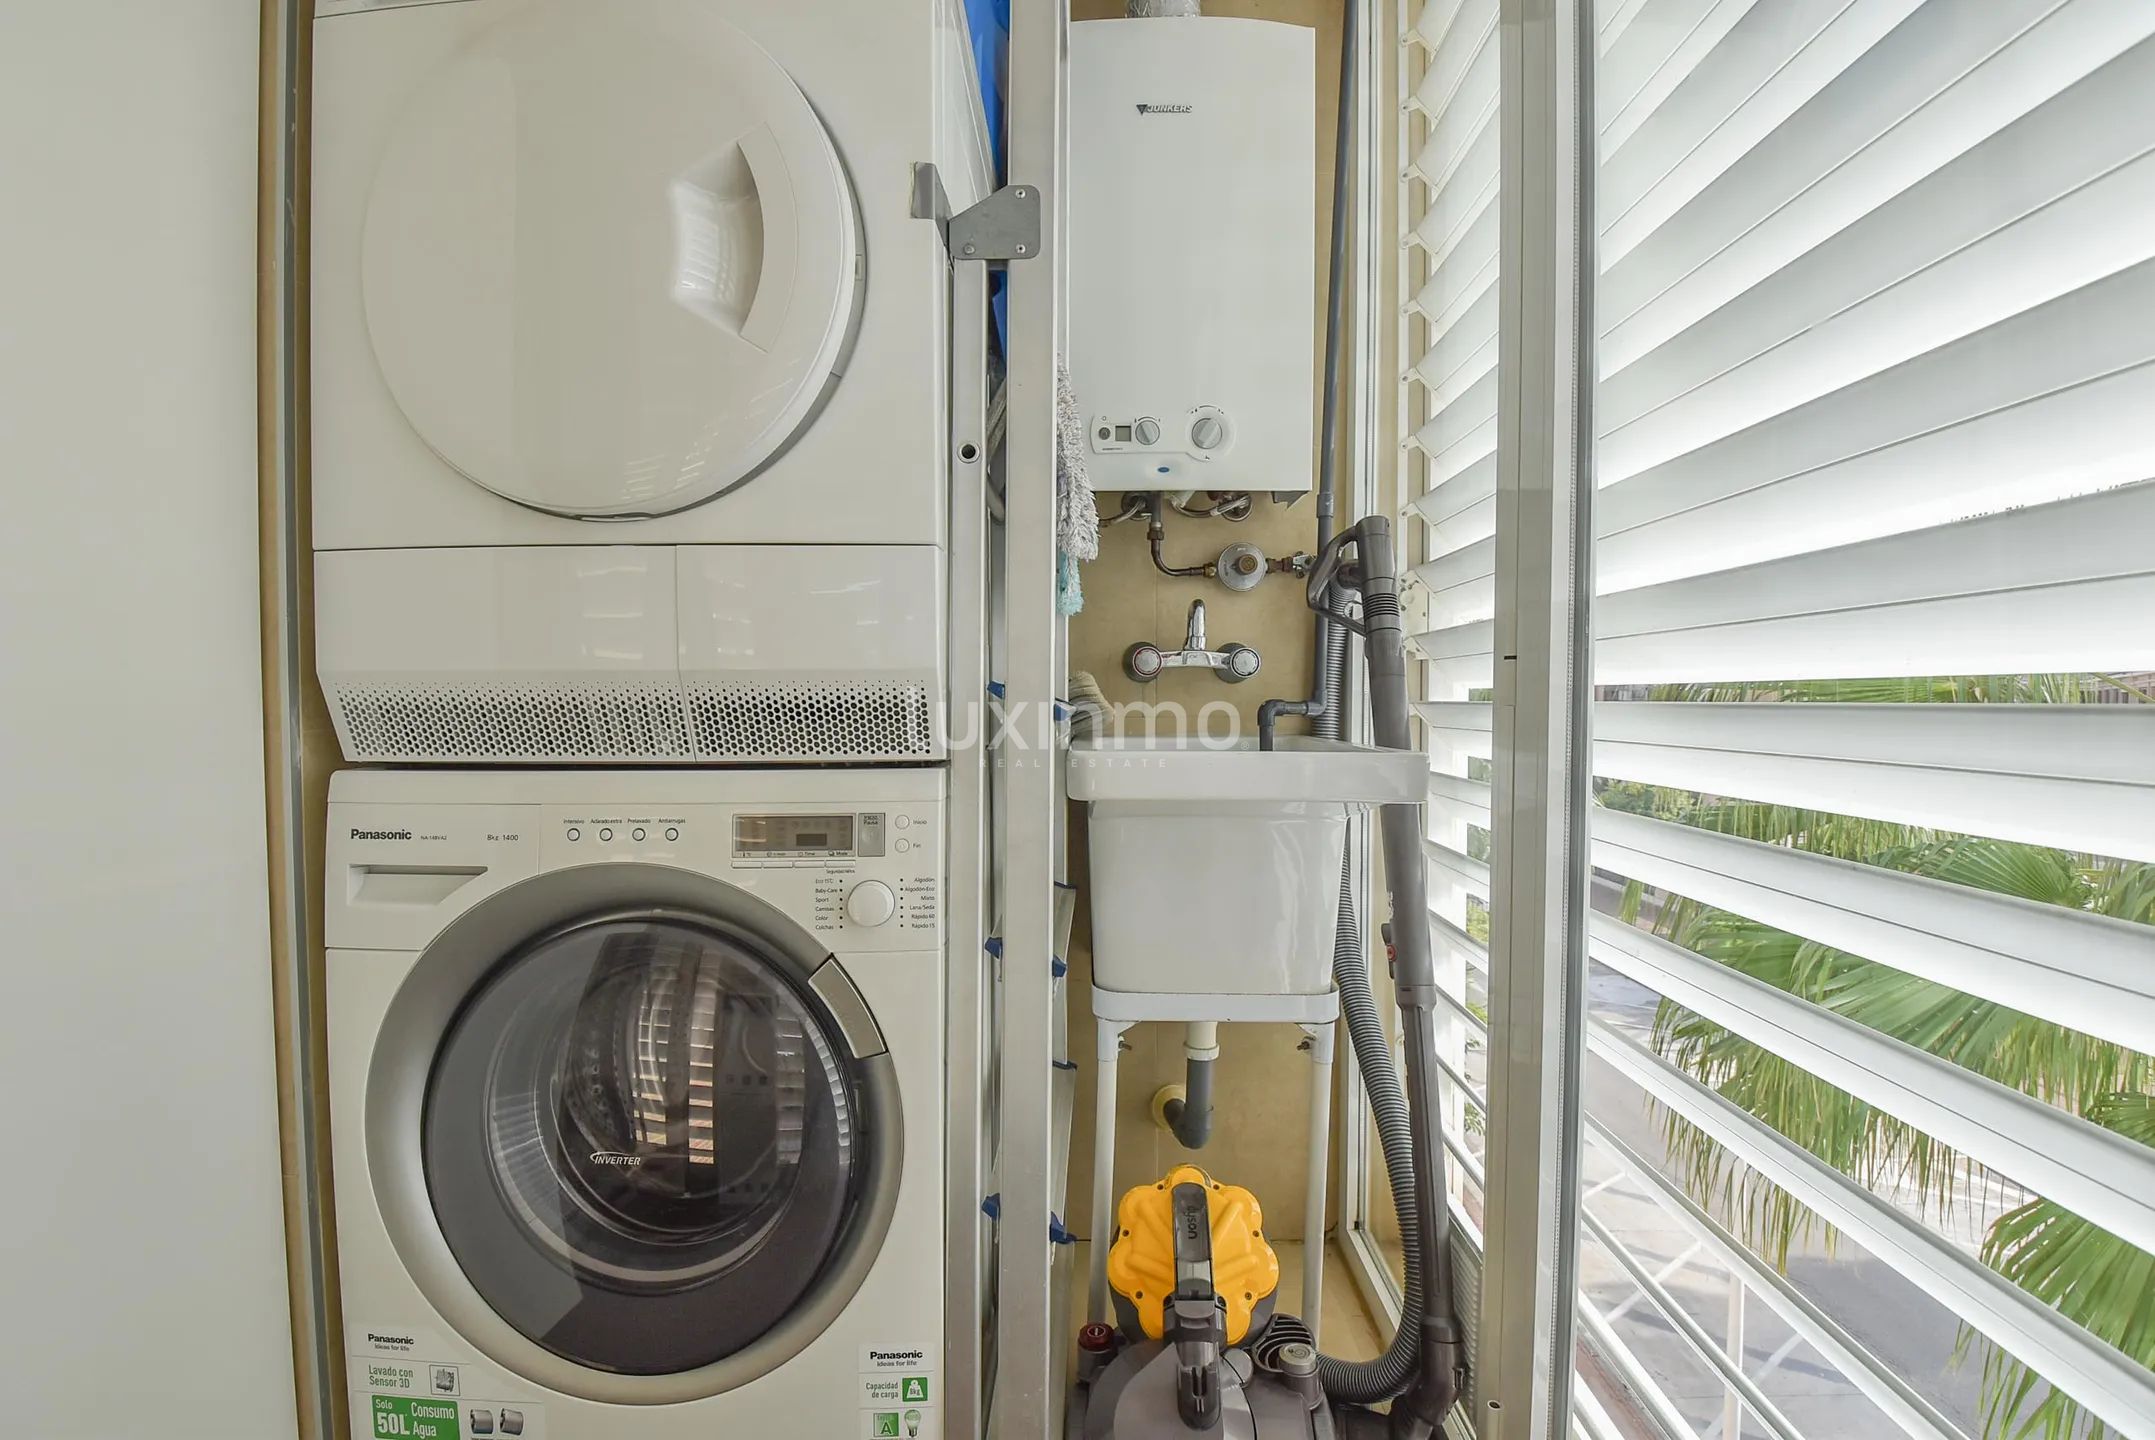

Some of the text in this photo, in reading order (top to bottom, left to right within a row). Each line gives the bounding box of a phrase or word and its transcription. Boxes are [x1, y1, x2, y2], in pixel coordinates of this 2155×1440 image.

[1146, 104, 1193, 114] JUNKERS
[350, 828, 412, 841] Panasonic
[594, 1156, 641, 1165] INVERTER
[1184, 1205, 1198, 1240] dyson
[367, 1333, 415, 1345] Panasonic
[870, 1350, 924, 1360] Panasonic
[368, 1364, 414, 1378] Lavado con
[369, 1375, 411, 1389] Sensor 3D
[865, 1382, 899, 1391] Capacidad
[880, 1391, 899, 1399] carga
[375, 1399, 393, 1410] Solo
[410, 1401, 455, 1420] Consumo
[412, 1420, 437, 1439] Agua
[880, 1421, 893, 1435] A
